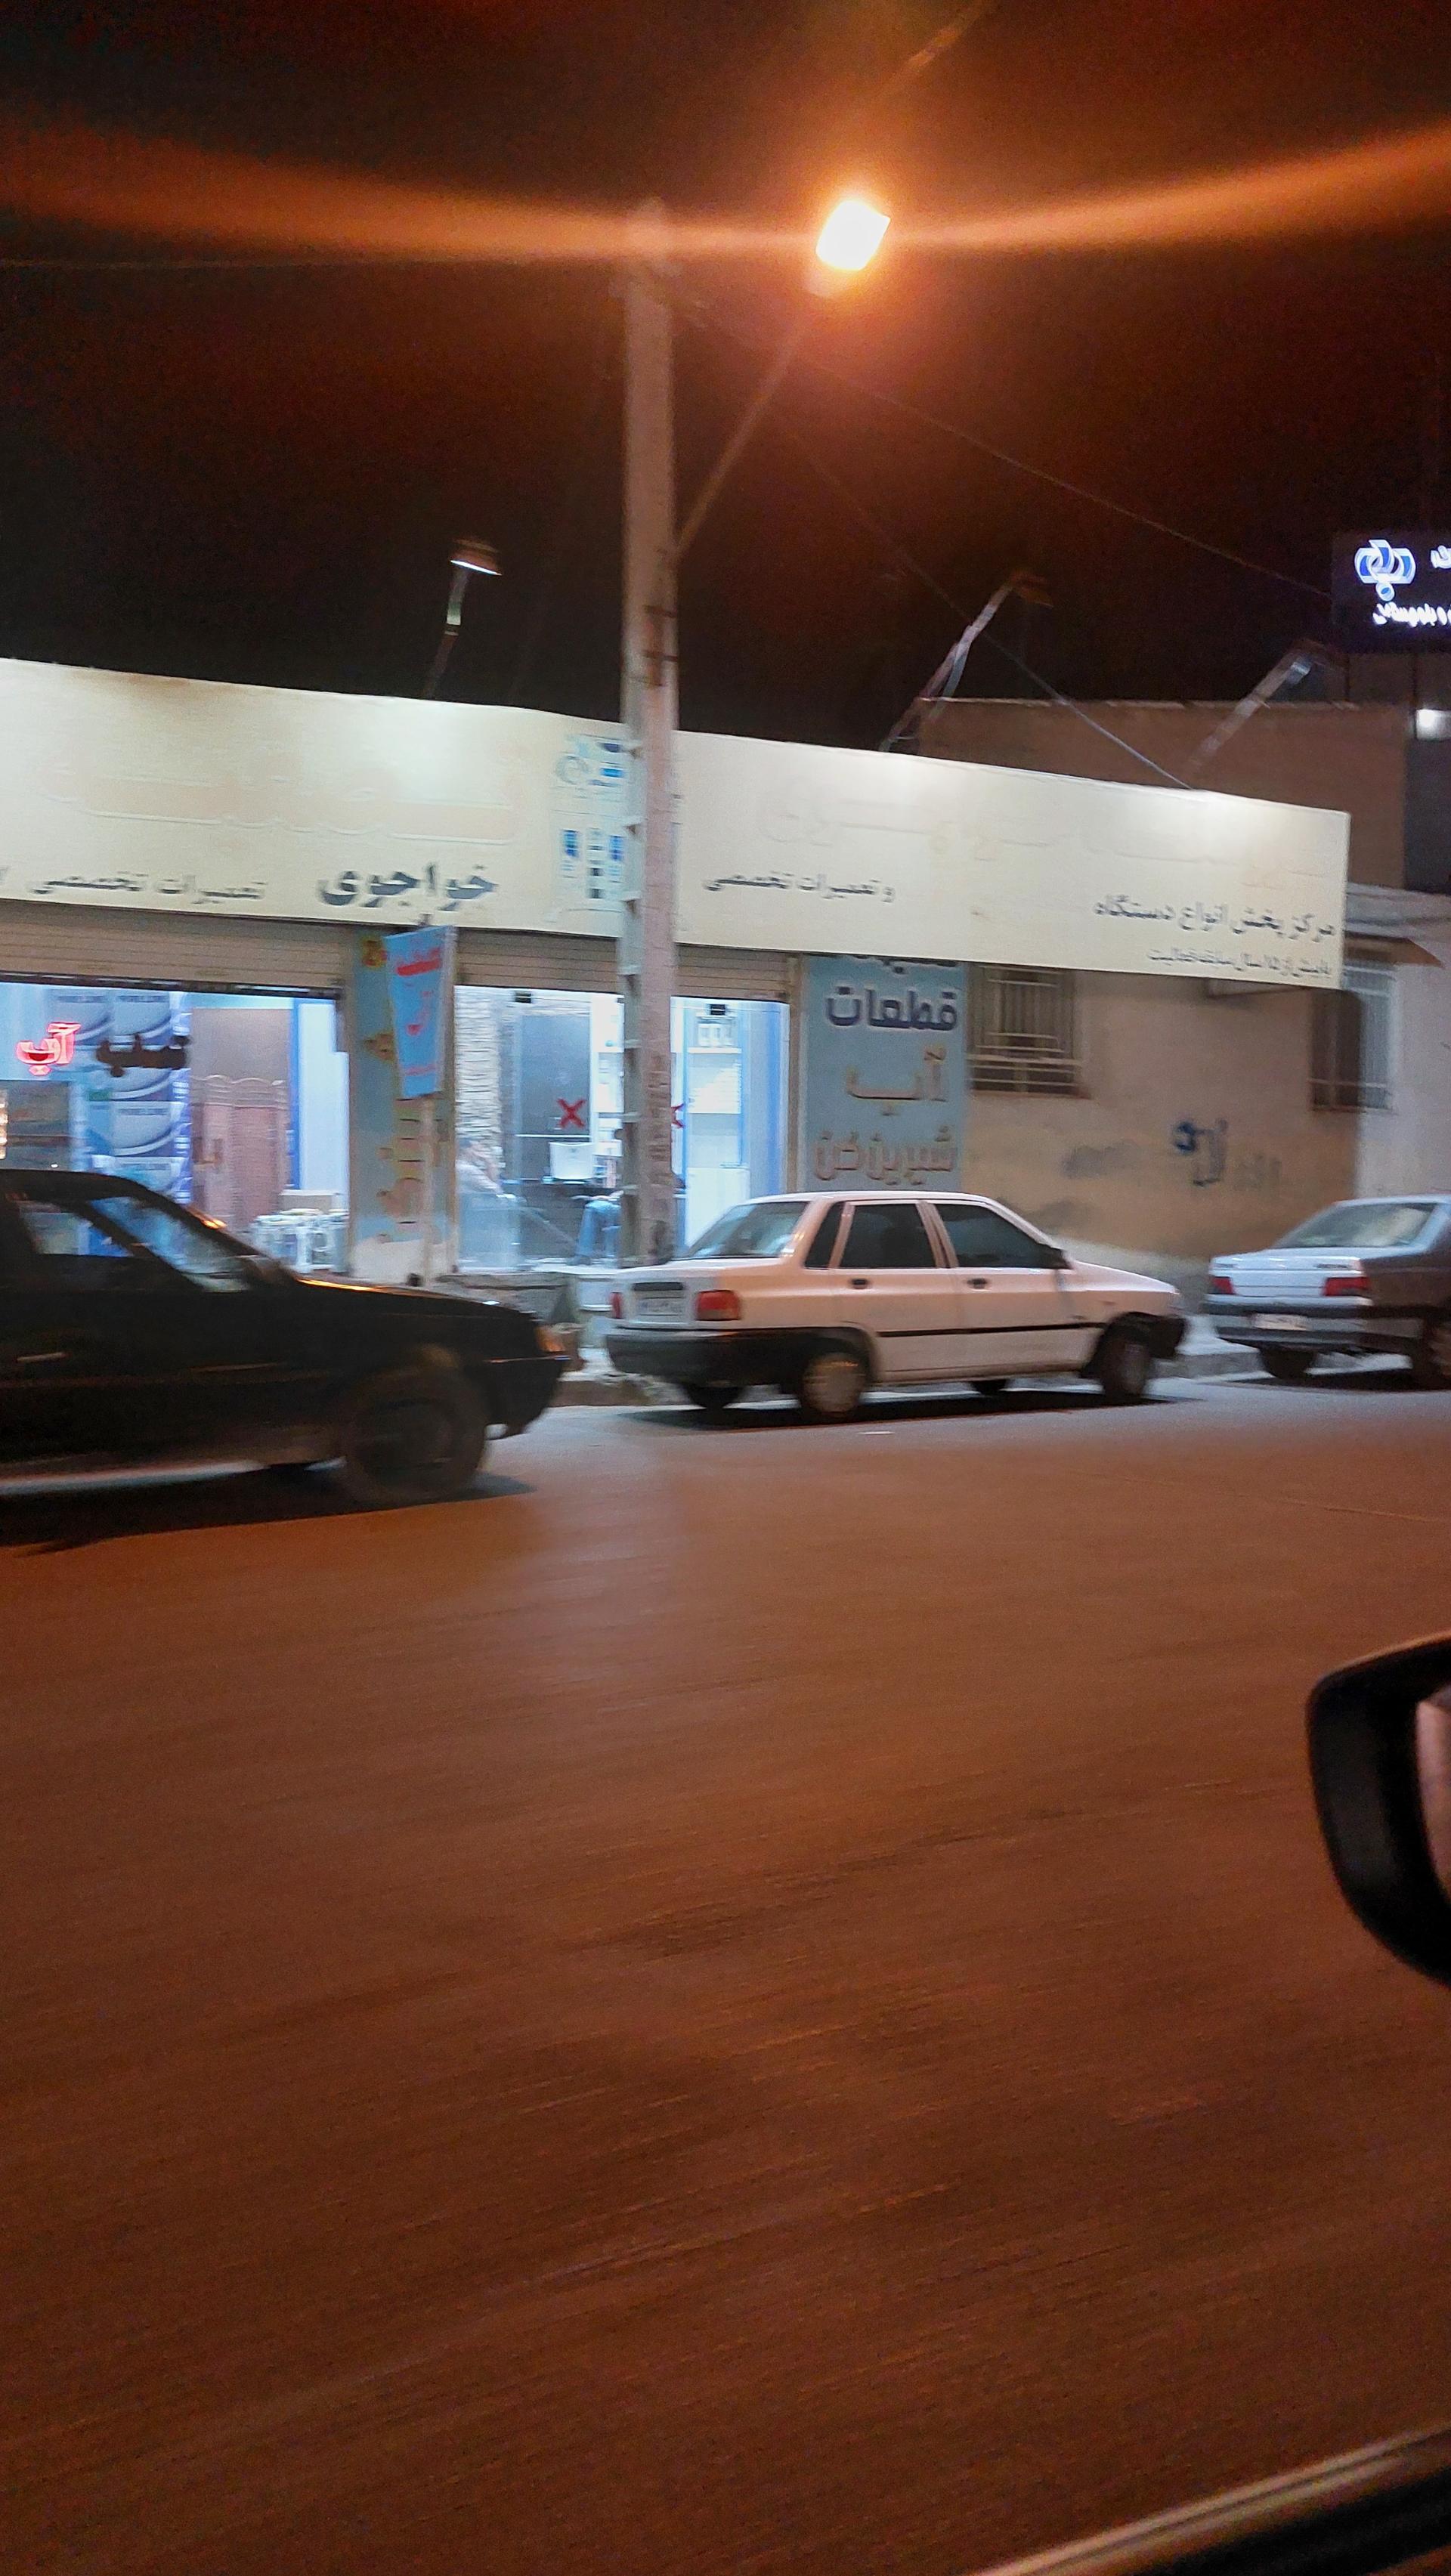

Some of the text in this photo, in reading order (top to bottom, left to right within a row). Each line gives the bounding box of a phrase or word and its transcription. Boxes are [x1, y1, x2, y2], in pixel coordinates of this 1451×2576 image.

[29, 870, 149, 895] تخصصی
[702, 869, 795, 892] تخصصی
[797, 872, 881, 900] تعمیرات
[1094, 894, 1335, 943] مرکز پخش انواع دستگاه
[826, 985, 958, 1031] قطعات
[16, 1020, 82, 1076] آب
[844, 1044, 948, 1117] آب
